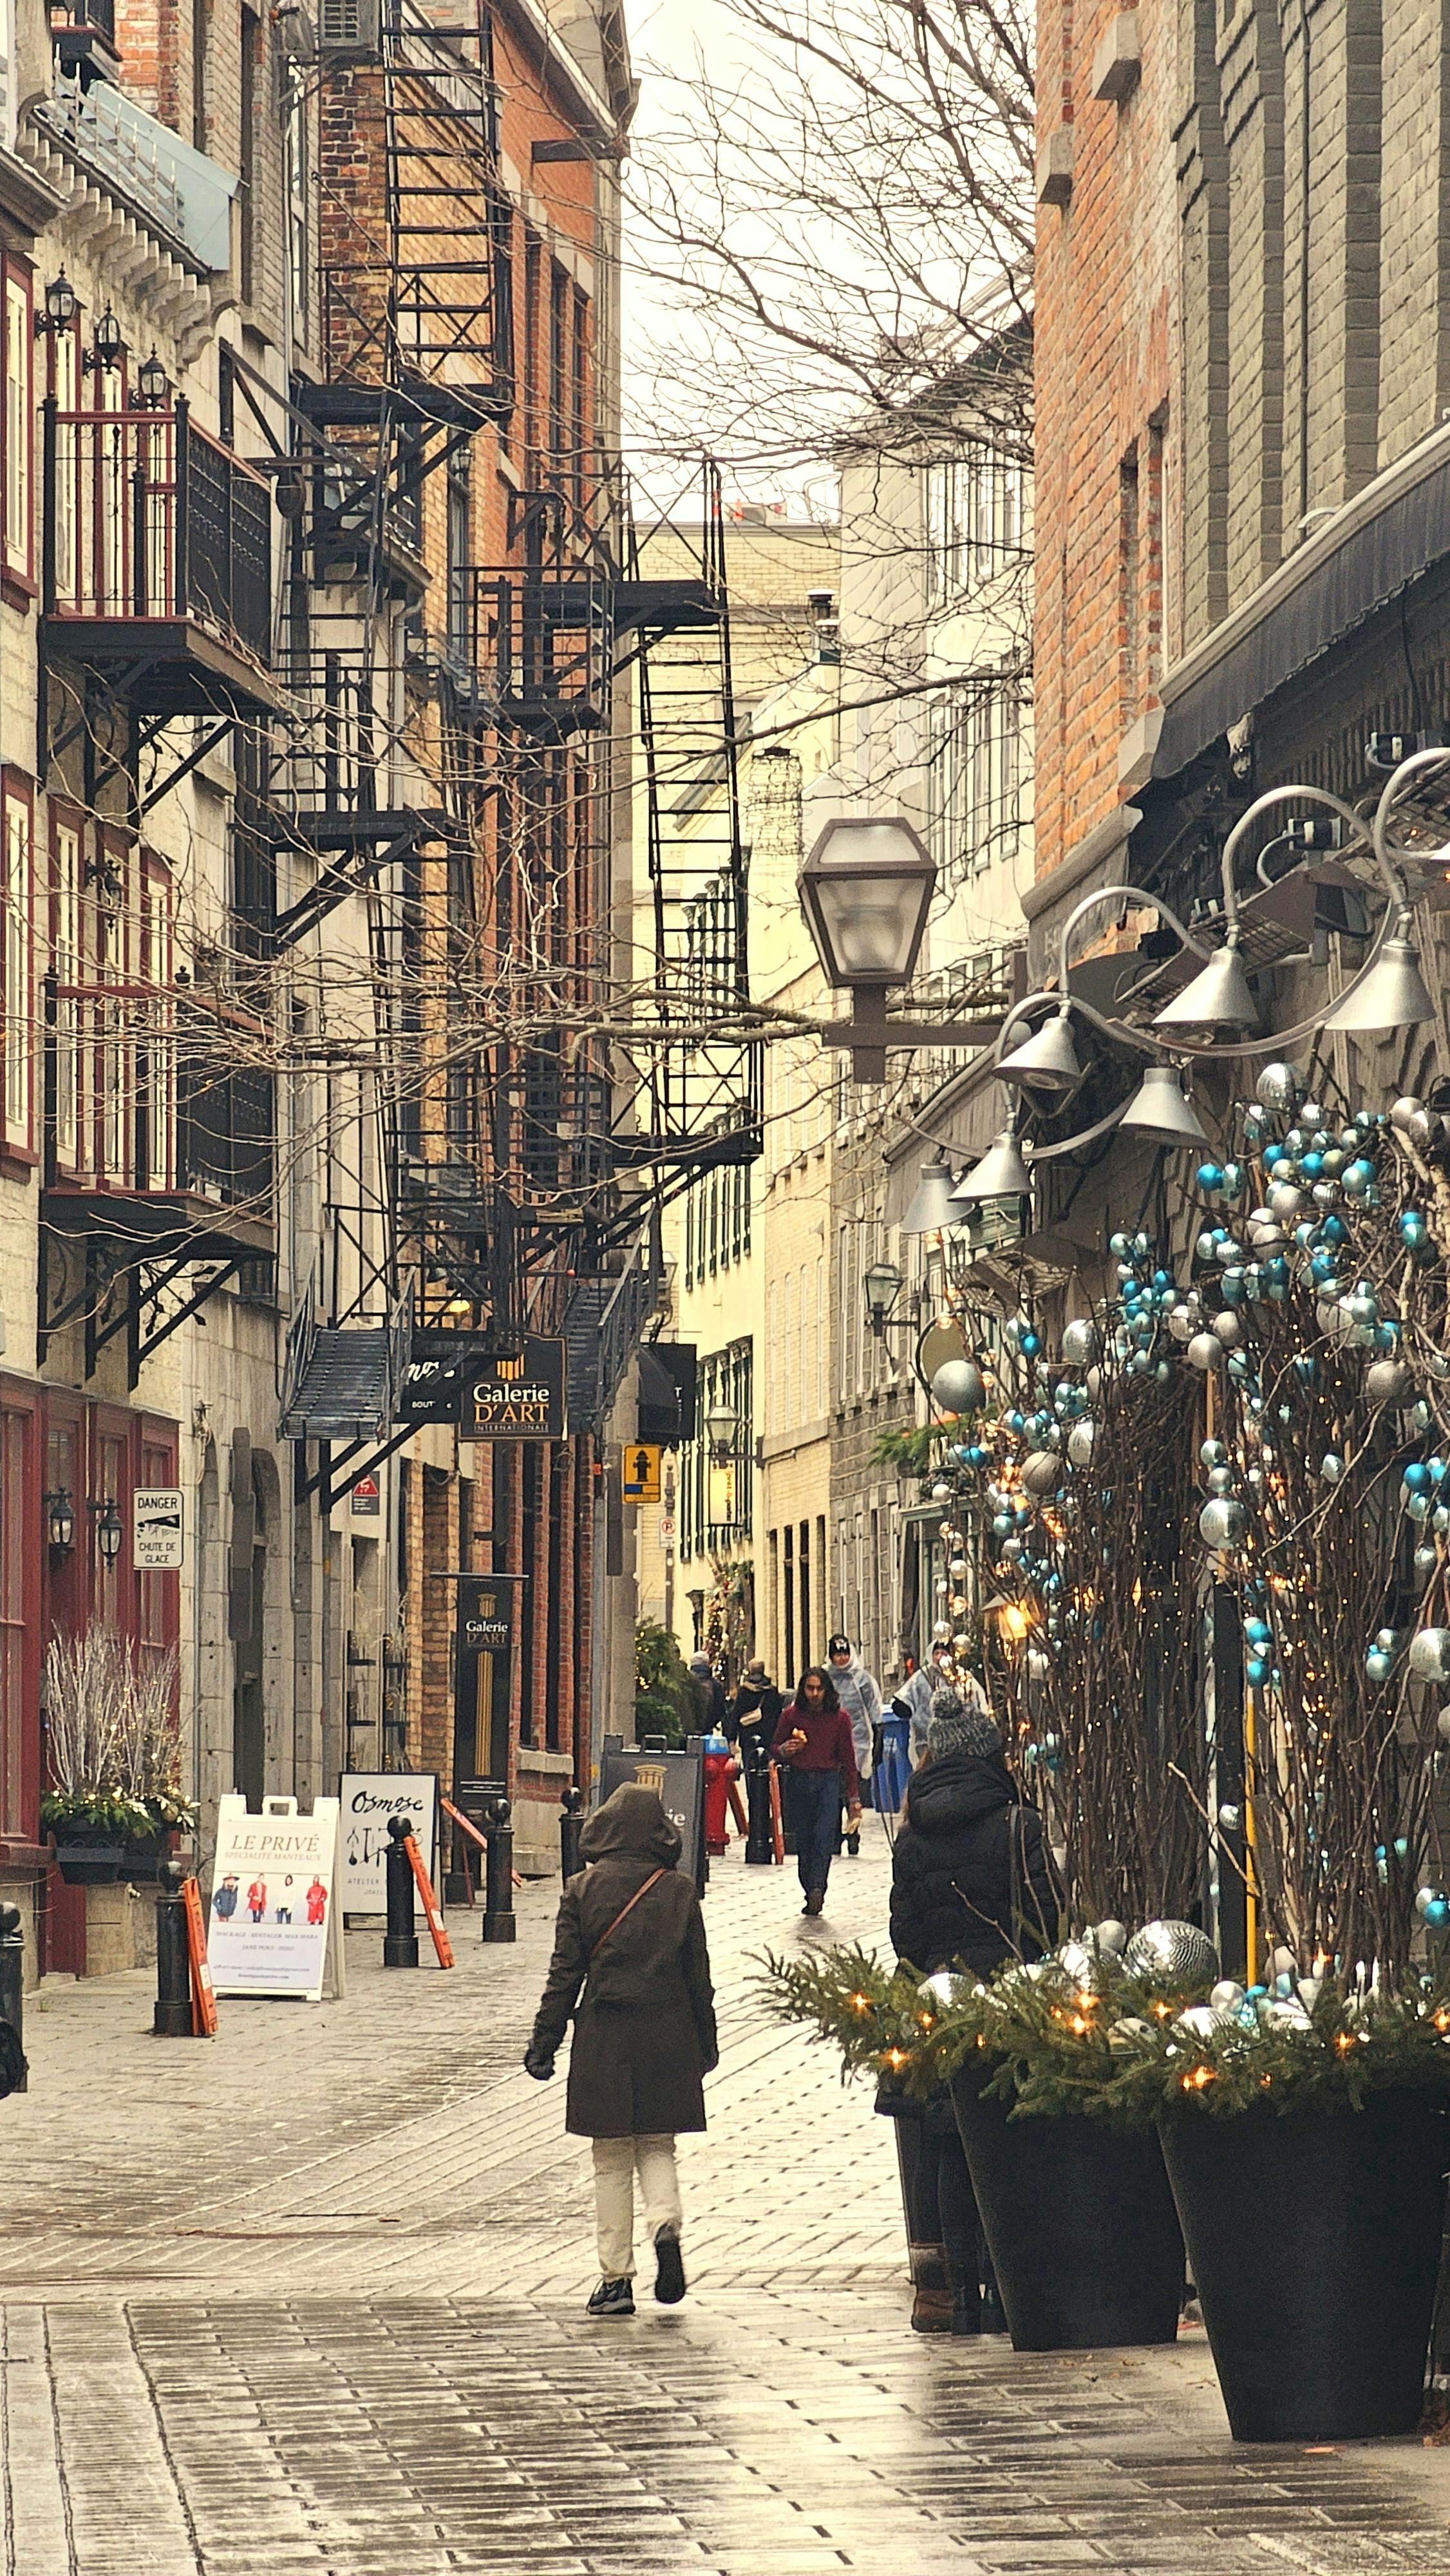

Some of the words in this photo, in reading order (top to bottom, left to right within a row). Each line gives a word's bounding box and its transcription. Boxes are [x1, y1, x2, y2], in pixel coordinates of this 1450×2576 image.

[473, 1383, 549, 1403] Galerie
[475, 1404, 549, 1423] D'ART
[138, 1497, 178, 1508] DANGER
[139, 1542, 163, 1551] CHUTE
[165, 1542, 176, 1551] DE
[145, 1554, 169, 1564] GLACE
[466, 1620, 508, 1633] Galerie
[466, 1633, 507, 1643] D'ART
[352, 1791, 423, 1813] Osmose
[231, 1835, 256, 1850] LE
[260, 1833, 319, 1852] PRIVÉ
[273, 1853, 321, 1861] MANTEAUX
